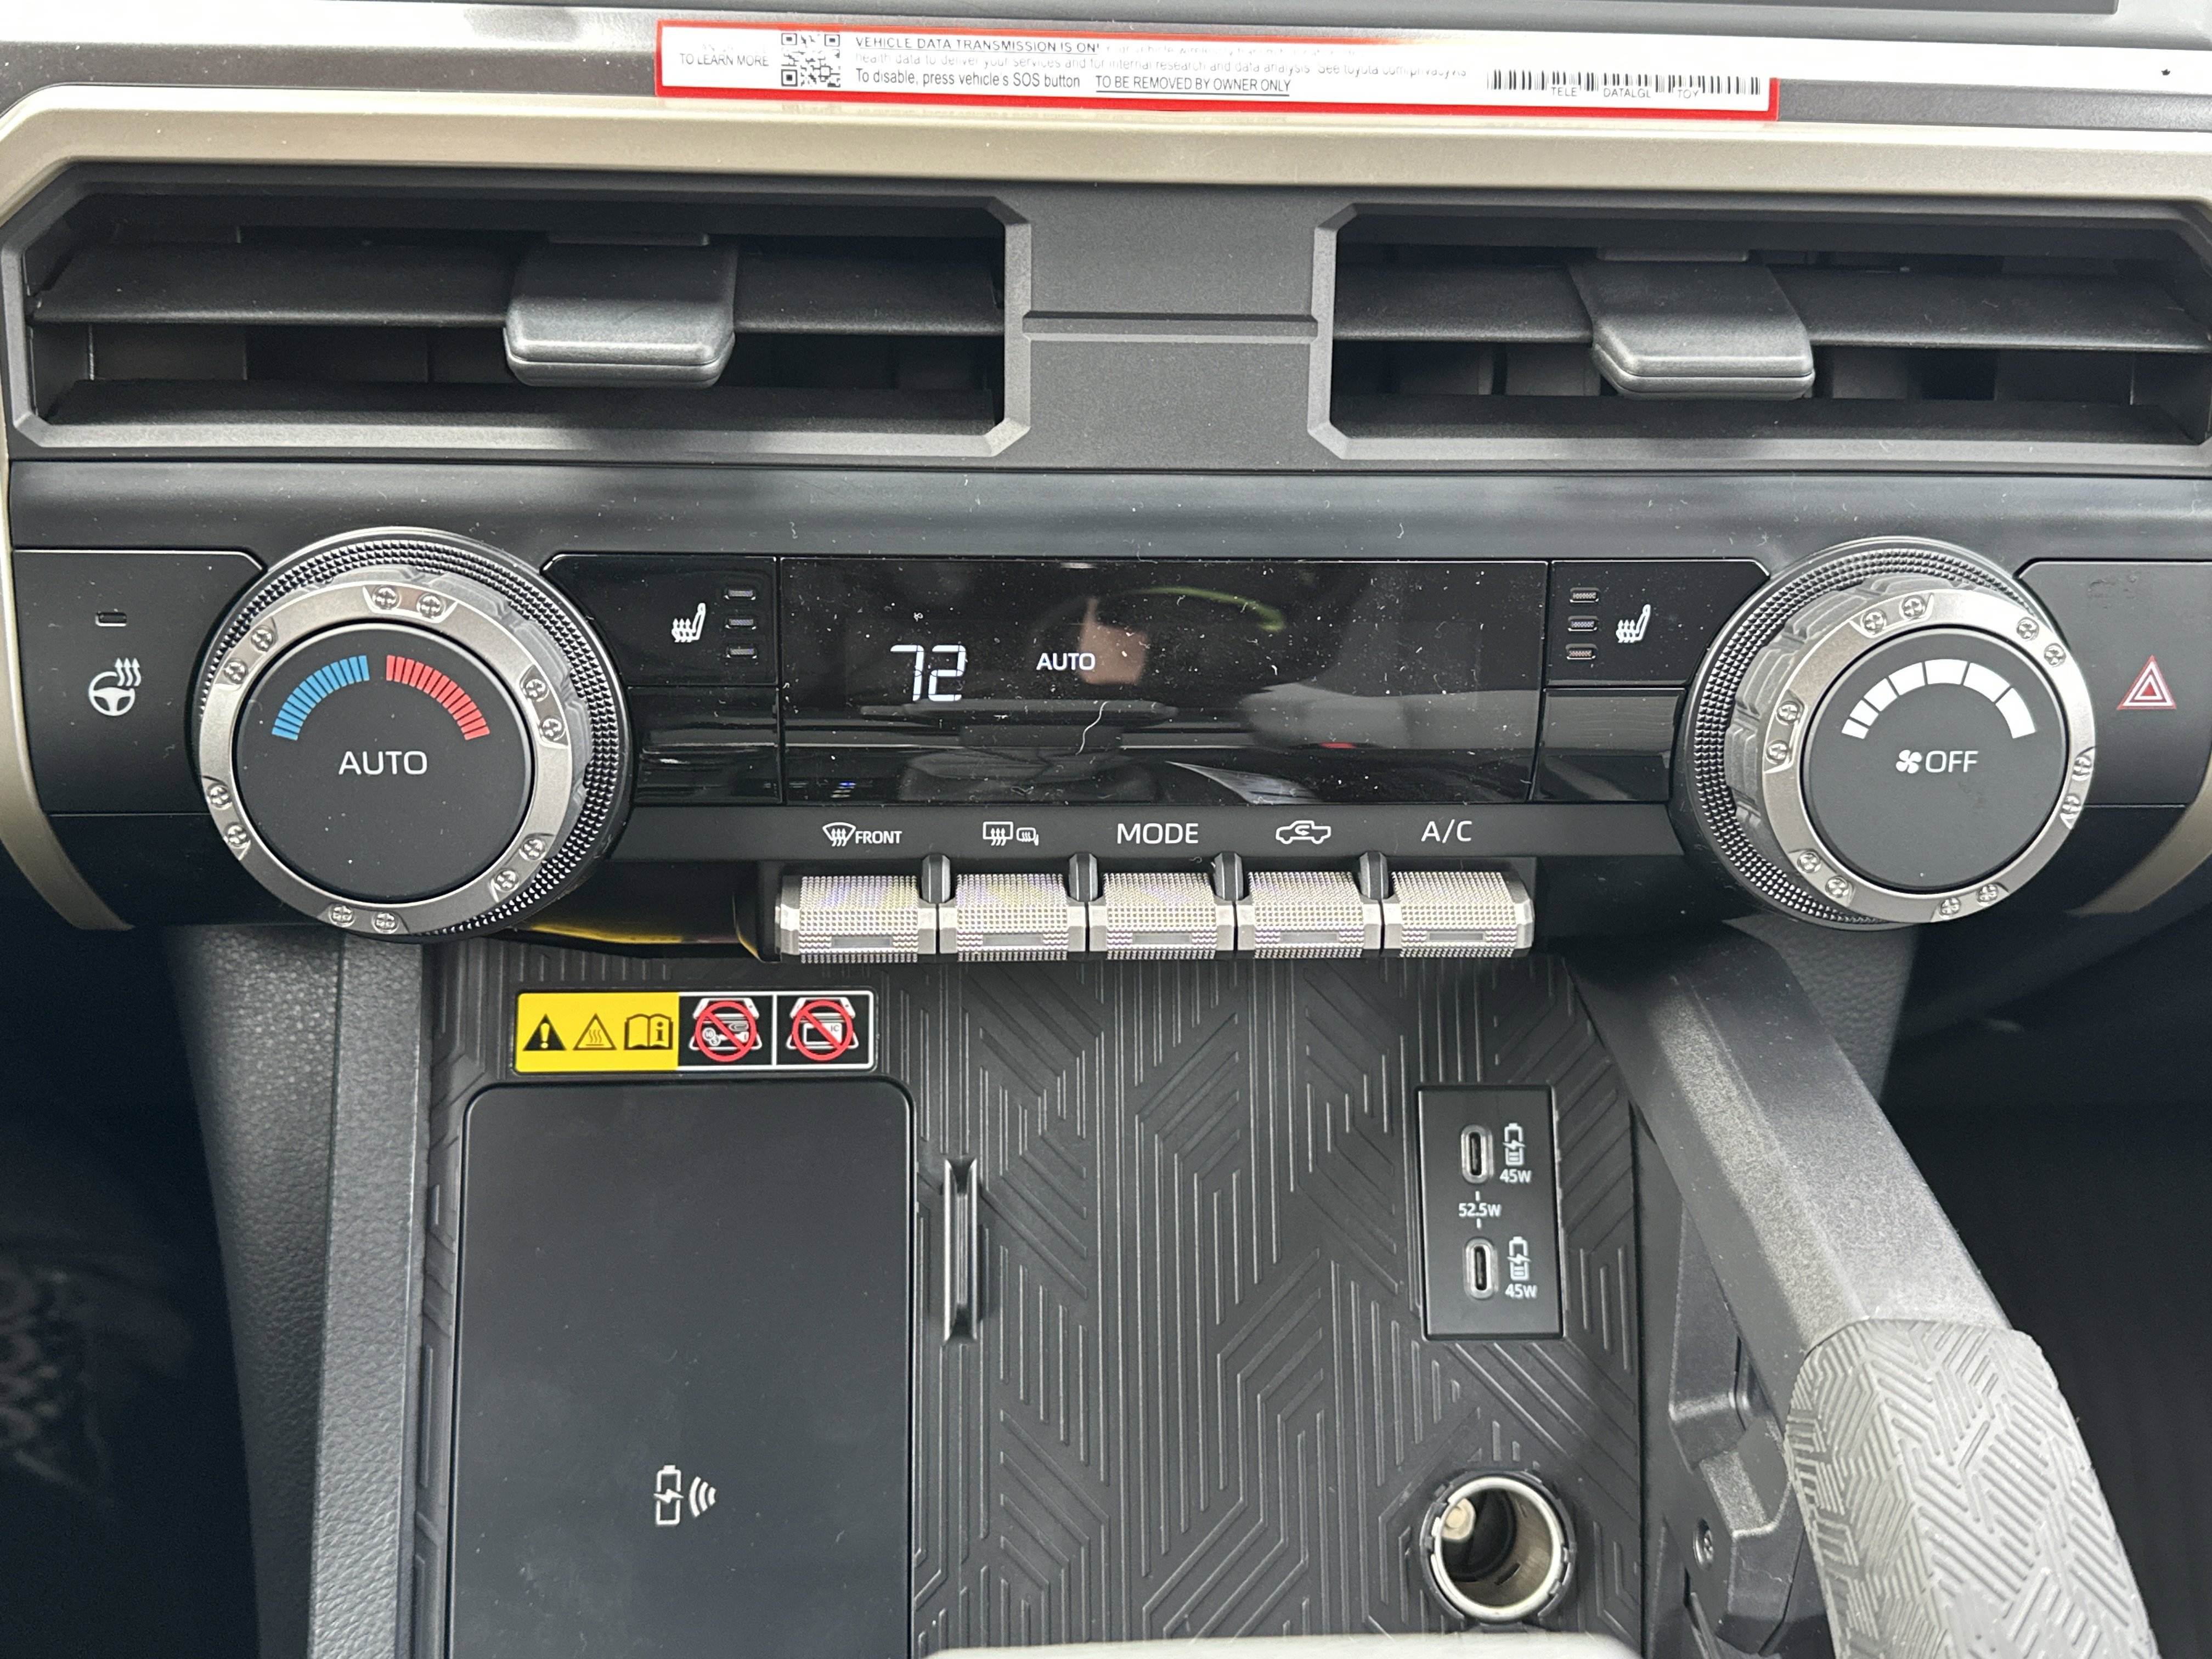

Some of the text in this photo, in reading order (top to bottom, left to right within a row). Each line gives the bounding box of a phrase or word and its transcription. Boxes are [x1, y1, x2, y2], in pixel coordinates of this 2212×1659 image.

[855, 36, 912, 48] VEHICLE
[917, 38, 951, 49] DATA
[956, 39, 1056, 52] TRANSMISSION
[1061, 42, 1072, 53] IS
[680, 53, 769, 66] TO LEARN MORE
[1065, 58, 1086, 69] and
[1210, 61, 1231, 72] and
[1235, 61, 1260, 72] data
[855, 68, 1080, 88] To disable, press vehicle's SOS button
[1096, 75, 1291, 92] TO BE REMOVED BY OWNER ONLY
[1550, 86, 1699, 99] TELE DATALGL TOY
[1036, 652, 1096, 672] AUTO
[890, 644, 966, 702] 72
[338, 750, 428, 775] AUTO
[1925, 751, 1978, 773] OFF
[854, 830, 902, 845] FRONT
[1117, 823, 1199, 845] MODE
[1421, 820, 1473, 843] A/C
[1499, 1169, 1531, 1183] 45W
[1458, 1202, 1502, 1218] 52.5W
[1505, 1284, 1537, 1299] 45W
